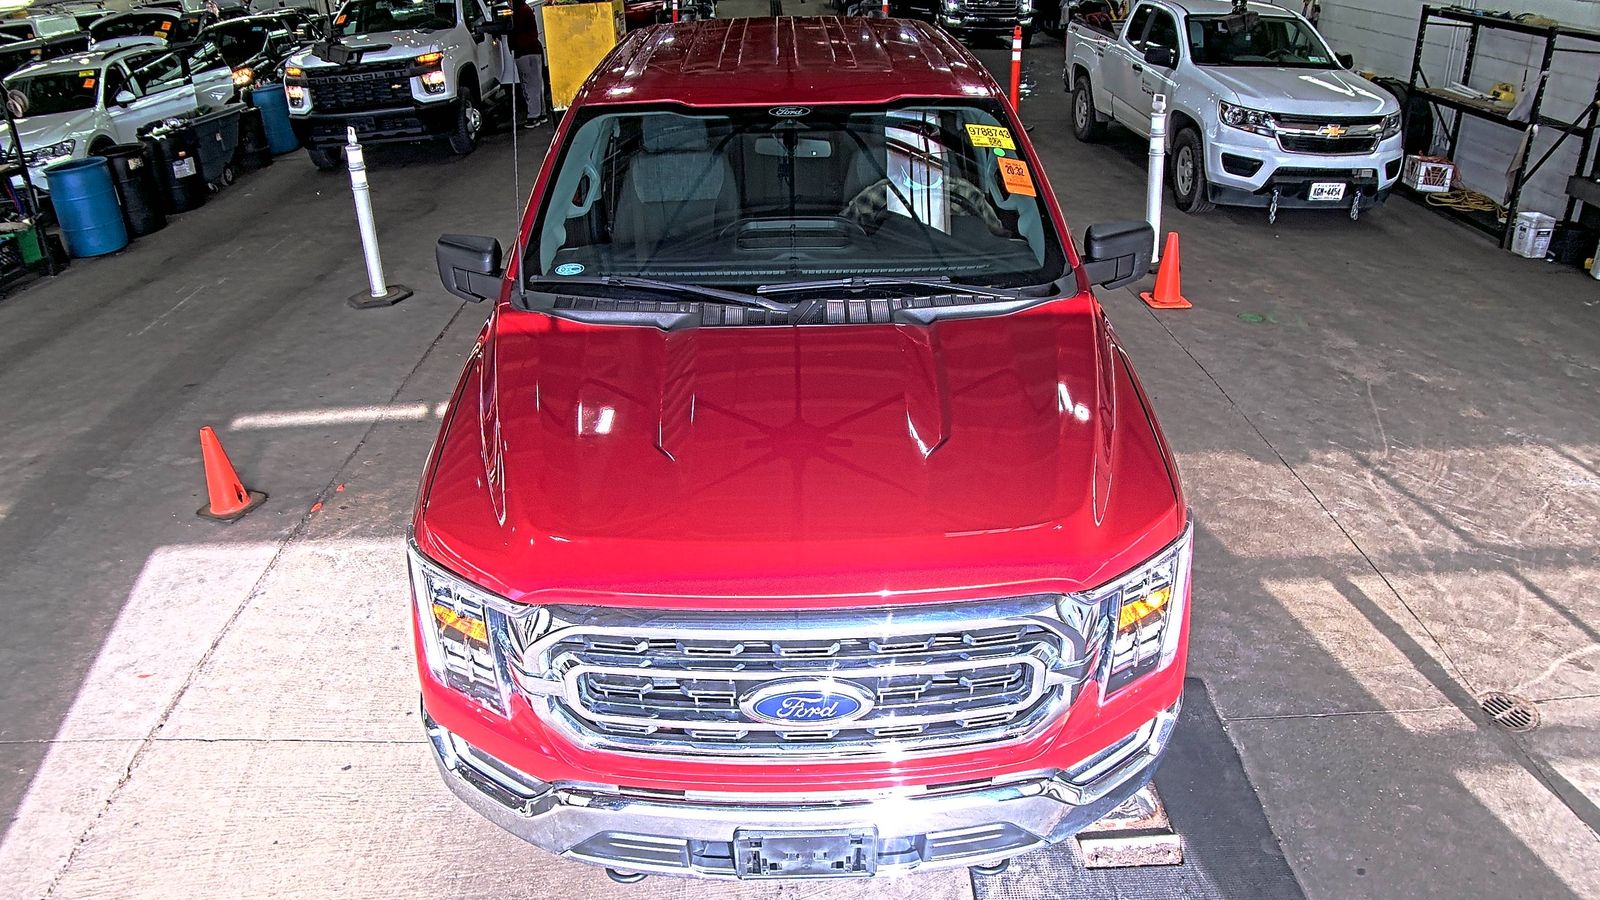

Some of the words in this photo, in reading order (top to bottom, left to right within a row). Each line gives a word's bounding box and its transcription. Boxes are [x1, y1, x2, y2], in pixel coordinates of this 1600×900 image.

[776, 107, 803, 115] Ford
[968, 126, 1011, 139] 9788743
[776, 696, 839, 718] Ford
